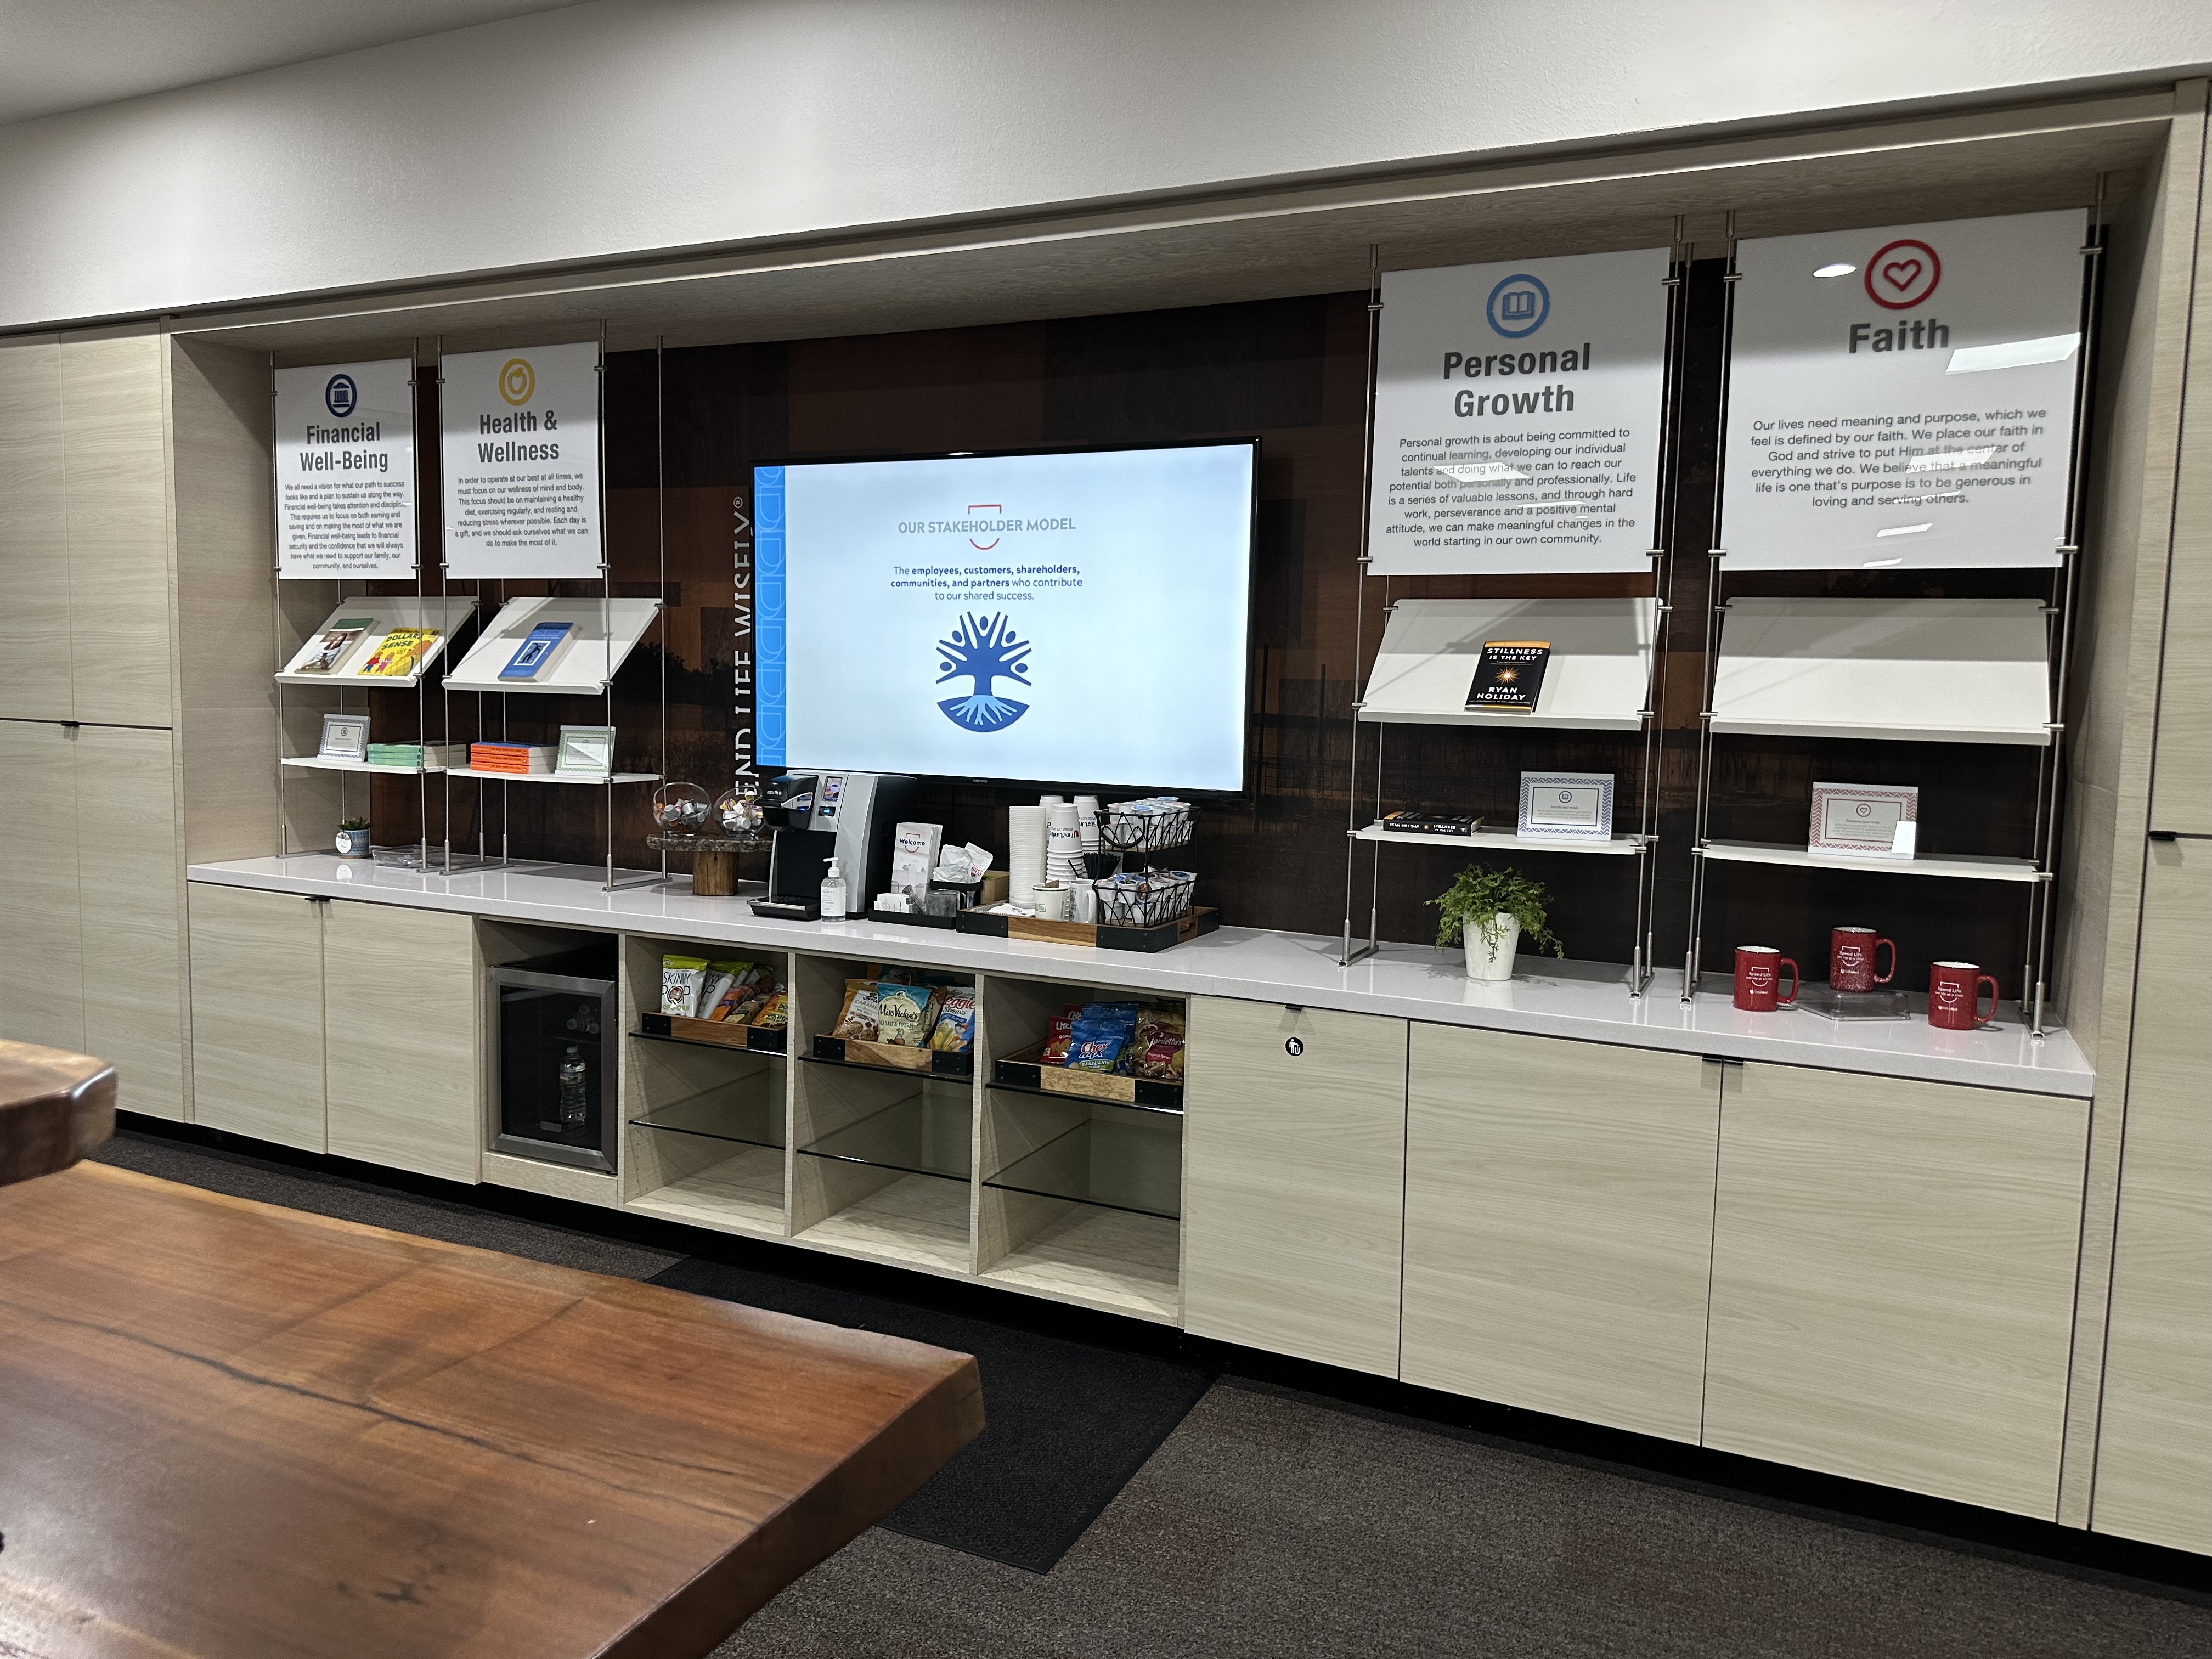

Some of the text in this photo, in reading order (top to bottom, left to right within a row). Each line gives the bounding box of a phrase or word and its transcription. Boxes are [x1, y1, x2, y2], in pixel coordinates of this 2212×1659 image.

[1848, 318, 1950, 354] Faith
[1443, 342, 1590, 379] Personal
[1454, 384, 1575, 417] Growth
[479, 410, 557, 435] Health &
[1752, 420, 1776, 430] Our
[1778, 419, 1805, 428] lives
[1807, 417, 1839, 427] need
[1840, 415, 1895, 428] meaning
[1896, 414, 1922, 424] and
[1923, 414, 1980, 425] purpose,
[1984, 409, 2023, 420] which
[307, 422, 380, 445] Financial
[1400, 428, 1629, 447] Personal growth is about being committed to
[1750, 436, 1770, 445] feel
[1774, 435, 1784, 444] is
[1787, 433, 1831, 444] defined
[1835, 432, 1850, 444] by
[1877, 430, 1906, 440] faith.
[1912, 430, 1932, 439] We
[1936, 428, 1970, 441] place
[2000, 426, 2027, 436] faith
[2032, 425, 2042, 435] in
[478, 441, 560, 463] Wellness
[1401, 450, 1446, 461] continual
[1449, 449, 1491, 461] learning,
[1494, 447, 1551, 459] developing
[1575, 444, 1626, 454] individual
[300, 450, 388, 472] Well-Being
[524, 496, 556, 505] maintaining
[563, 495, 584, 504] healthy
[289, 523, 304, 532] saving
[323, 522, 341, 531] making
[898, 517, 1076, 533] OUR STAKEHOLDER MODEL
[1385, 523, 1426, 534] attitude,
[1466, 522, 1494, 531] make
[1497, 520, 1554, 532] meaningful
[1556, 519, 1602, 531] changes
[1605, 518, 1615, 527] in
[1617, 518, 1635, 527] the
[1413, 537, 1442, 546] world
[1442, 537, 1482, 548] starting
[1483, 536, 1493, 545] in
[1539, 534, 1602, 546] community.
[895, 565, 1080, 577] The employees, customers, shareholders,
[890, 578, 1083, 589] communities, and partners who contribute
[963, 591, 994, 600] shared
[899, 838, 926, 847] Welcome
[663, 972, 691, 985] SKINNY
[855, 999, 878, 1009] CARAME
[944, 997, 975, 1009] eggie
[878, 1003, 895, 1016] Miss
[894, 1004, 918, 1022] Vickie's
[1081, 1041, 1112, 1054] Chex
